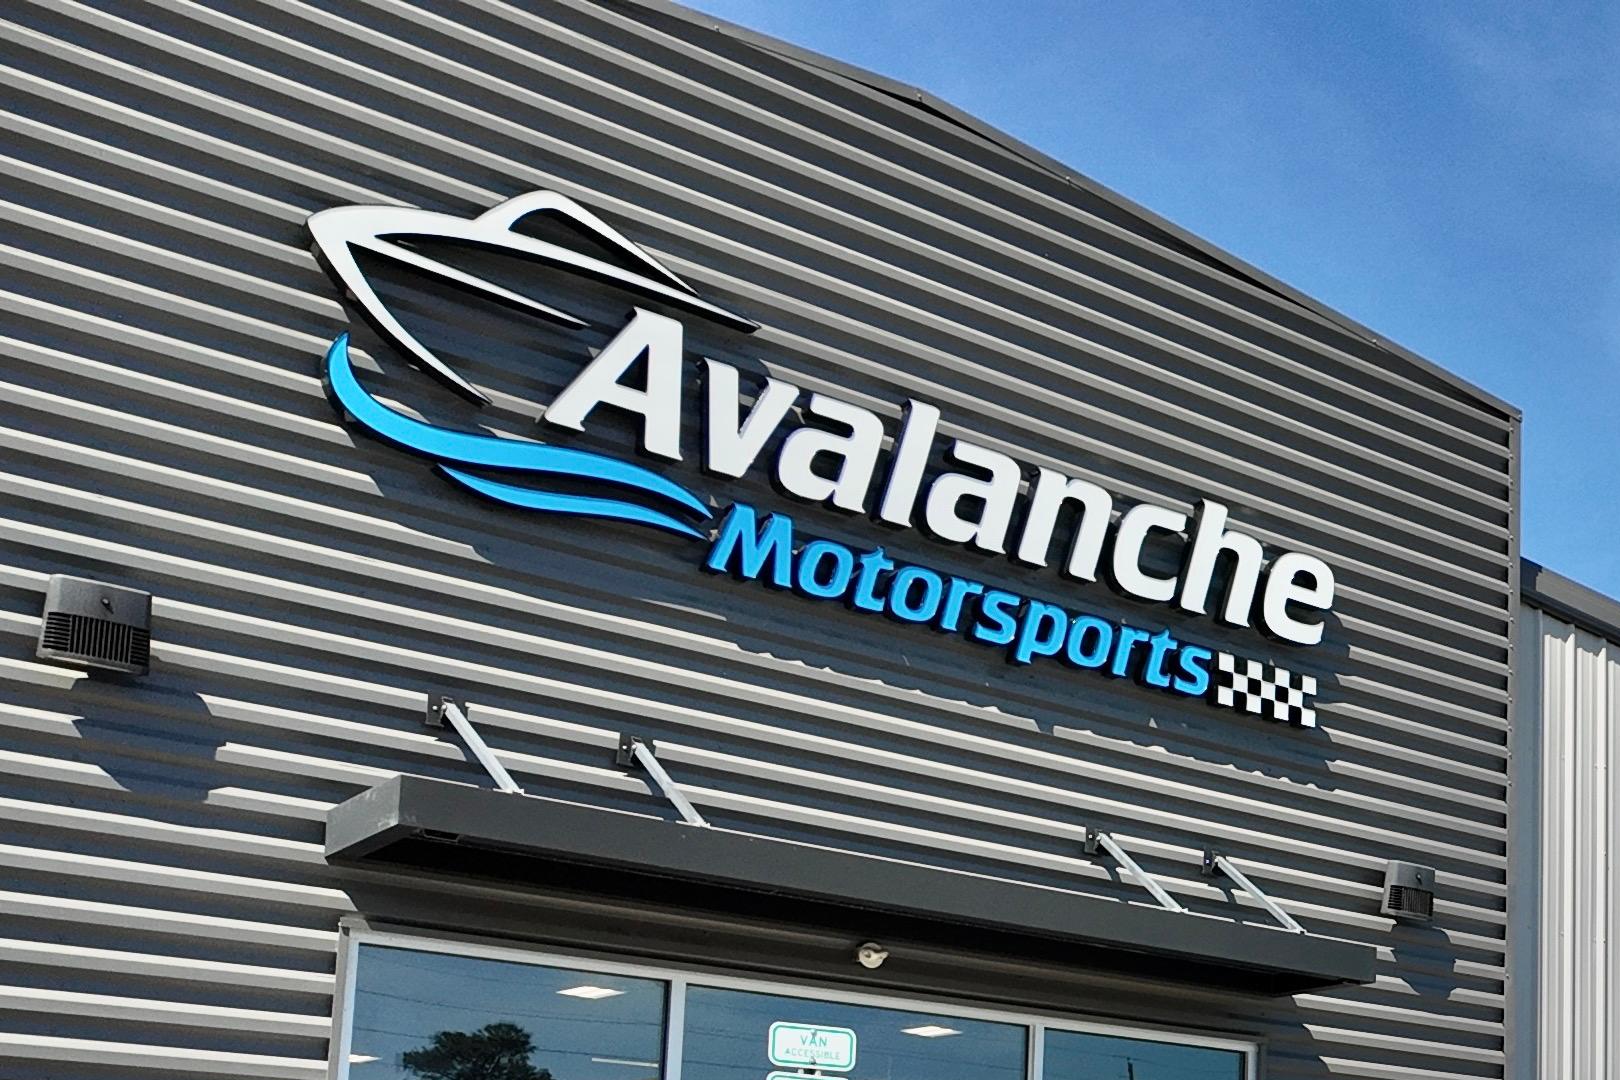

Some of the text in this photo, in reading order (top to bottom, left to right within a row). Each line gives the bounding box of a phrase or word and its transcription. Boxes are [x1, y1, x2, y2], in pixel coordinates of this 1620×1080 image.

[541, 308, 1335, 645] Avalanche
[705, 502, 1212, 696] Motorsports
[784, 1048, 841, 1060] ACCESSIBLE
[800, 1035, 828, 1047] VAN
